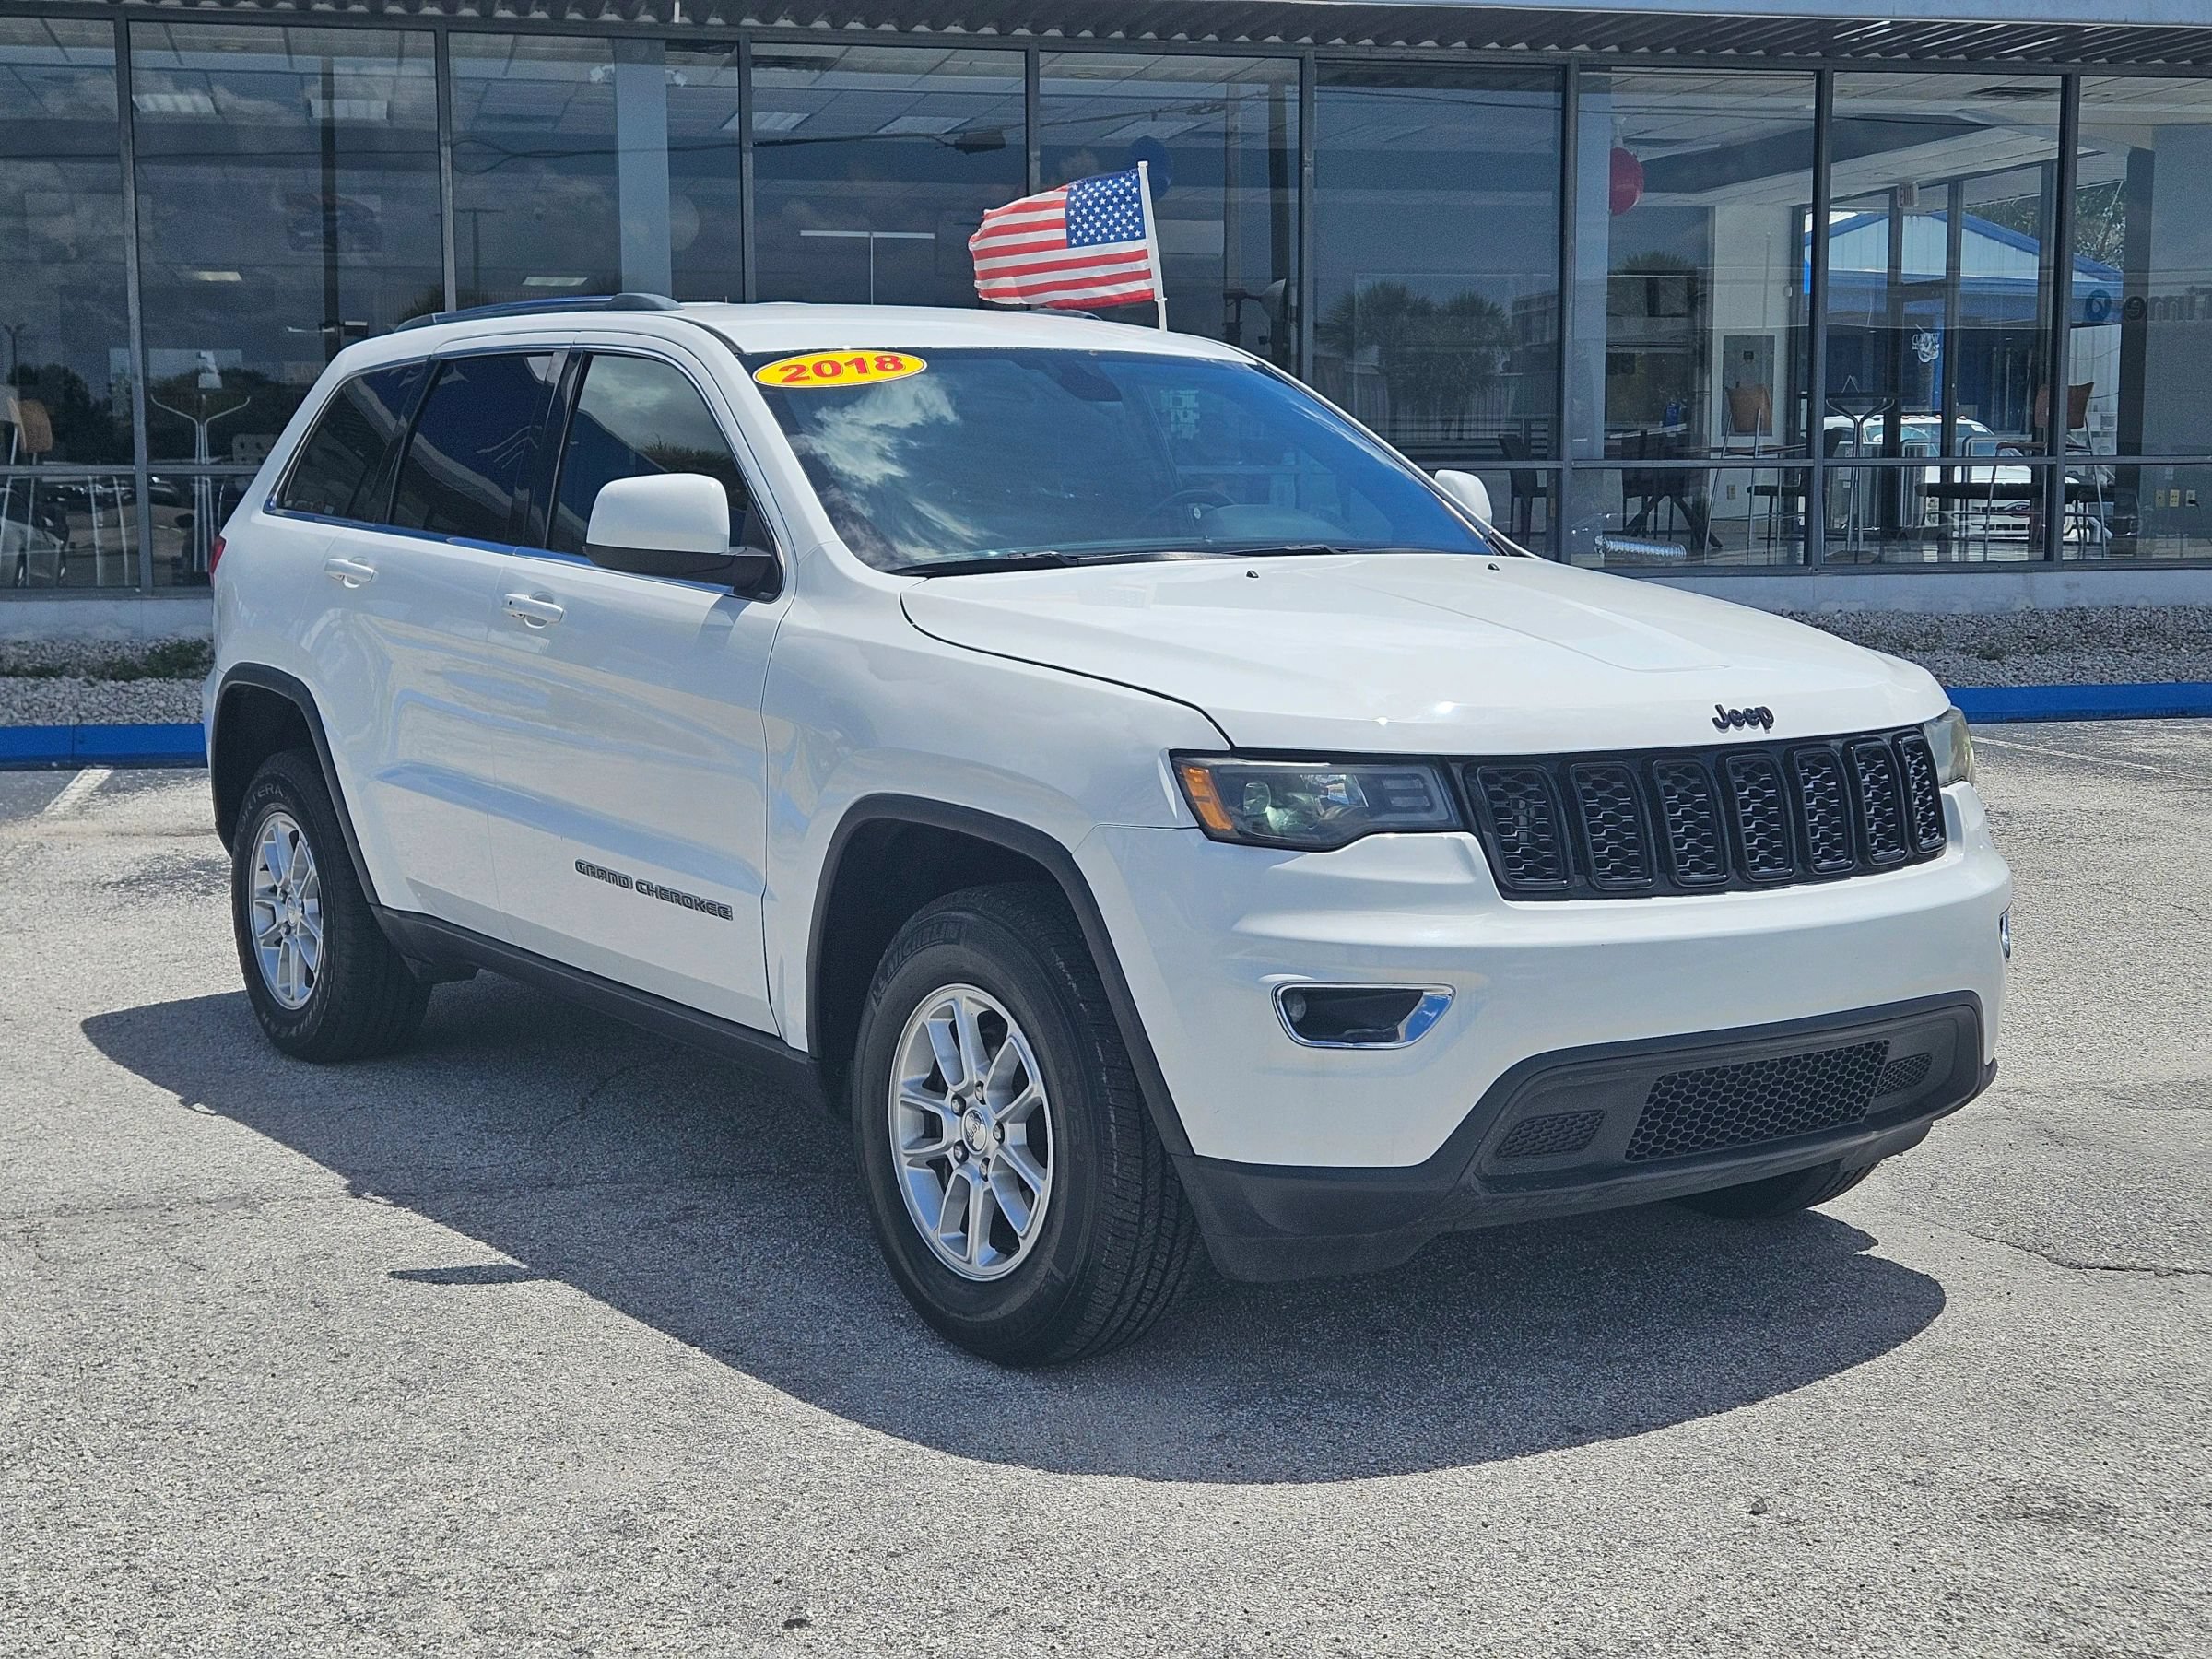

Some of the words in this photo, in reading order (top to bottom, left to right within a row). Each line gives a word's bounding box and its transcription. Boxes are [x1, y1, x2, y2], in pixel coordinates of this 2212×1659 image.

[778, 355, 906, 383] 2018
[1712, 704, 1774, 734] Jeep
[574, 858, 633, 889] GRAND
[635, 878, 734, 921] CHEROKEE
